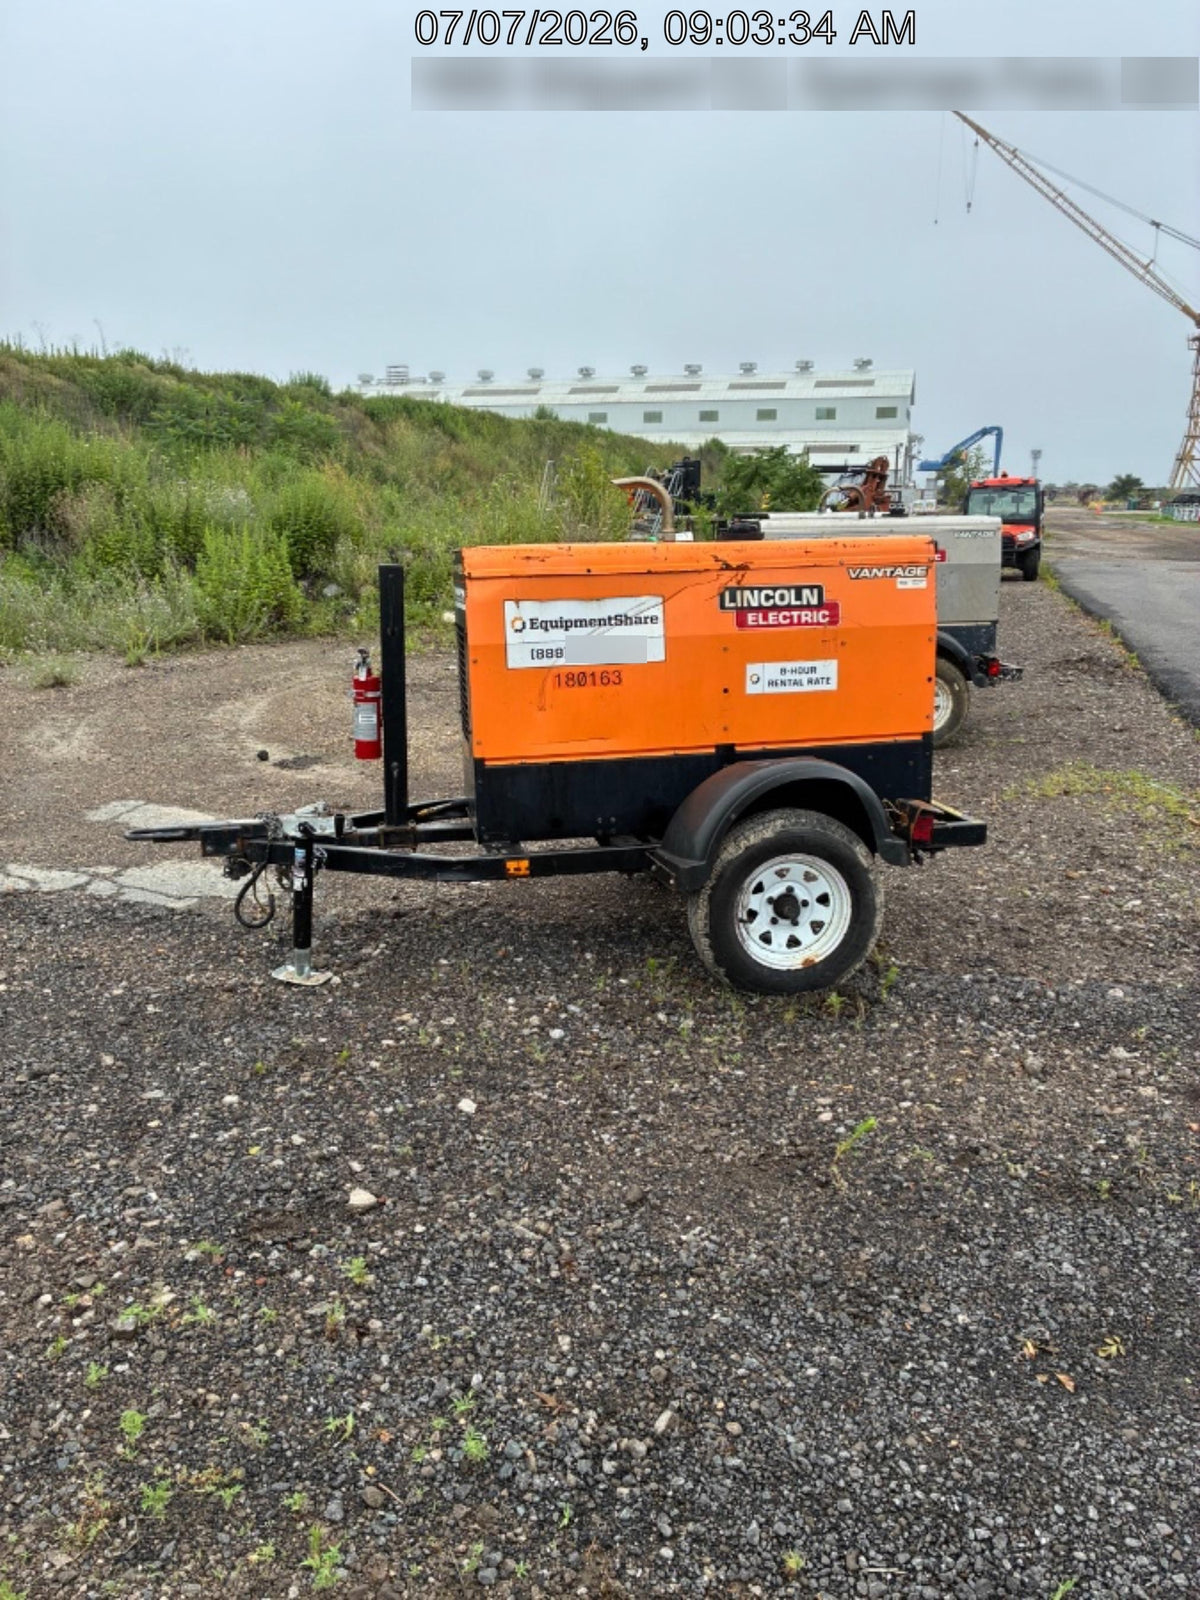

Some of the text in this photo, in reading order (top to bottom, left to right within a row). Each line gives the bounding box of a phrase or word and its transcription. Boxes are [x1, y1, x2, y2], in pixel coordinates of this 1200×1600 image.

[848, 566, 928, 579] VANTAGE
[723, 587, 819, 609] LINCOLN
[528, 614, 659, 632] EquipmentShare
[746, 609, 830, 626] ELECTRIC
[554, 669, 623, 688] 180163
[779, 665, 818, 676] 8-HOUR
[766, 676, 832, 688] RENTAL RATE
